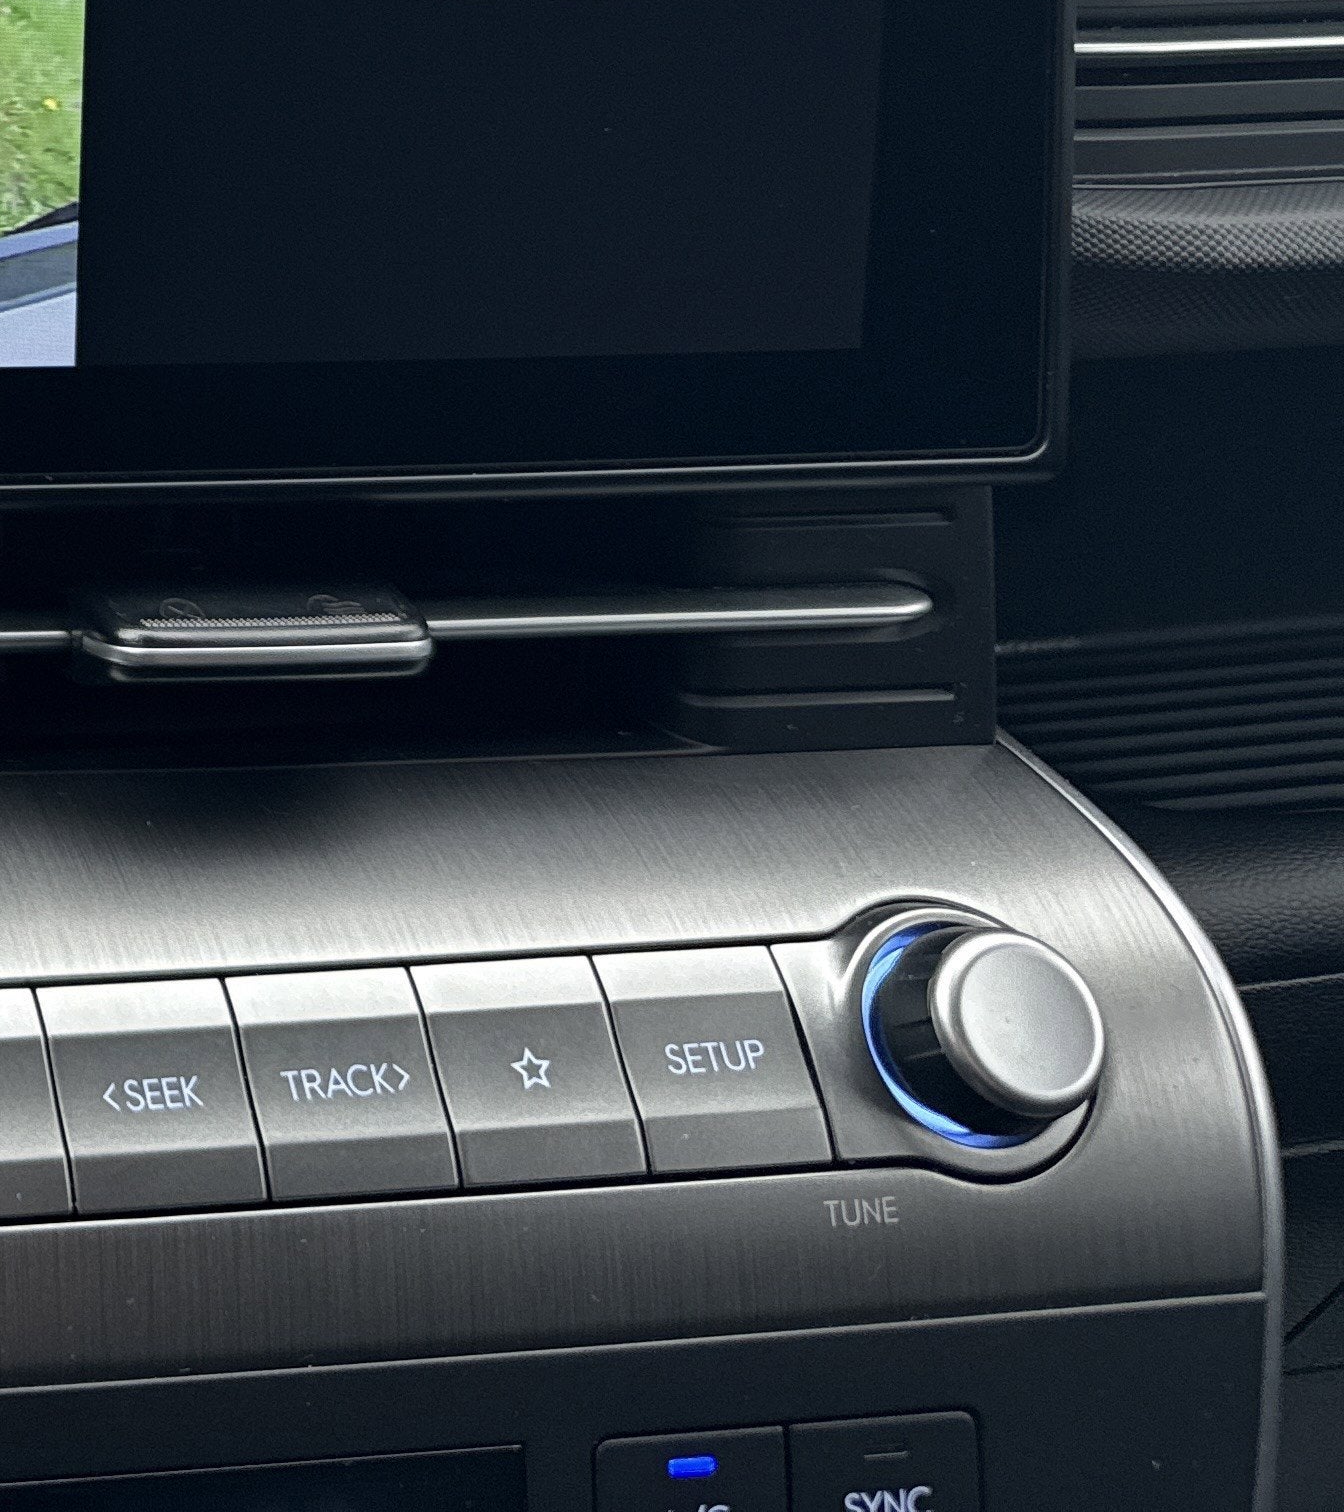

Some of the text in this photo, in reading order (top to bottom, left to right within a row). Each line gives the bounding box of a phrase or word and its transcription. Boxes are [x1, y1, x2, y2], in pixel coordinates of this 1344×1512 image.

[664, 1038, 766, 1076] SETUP
[822, 1195, 901, 1229] TUNE
[843, 1485, 933, 1512] SYNC
